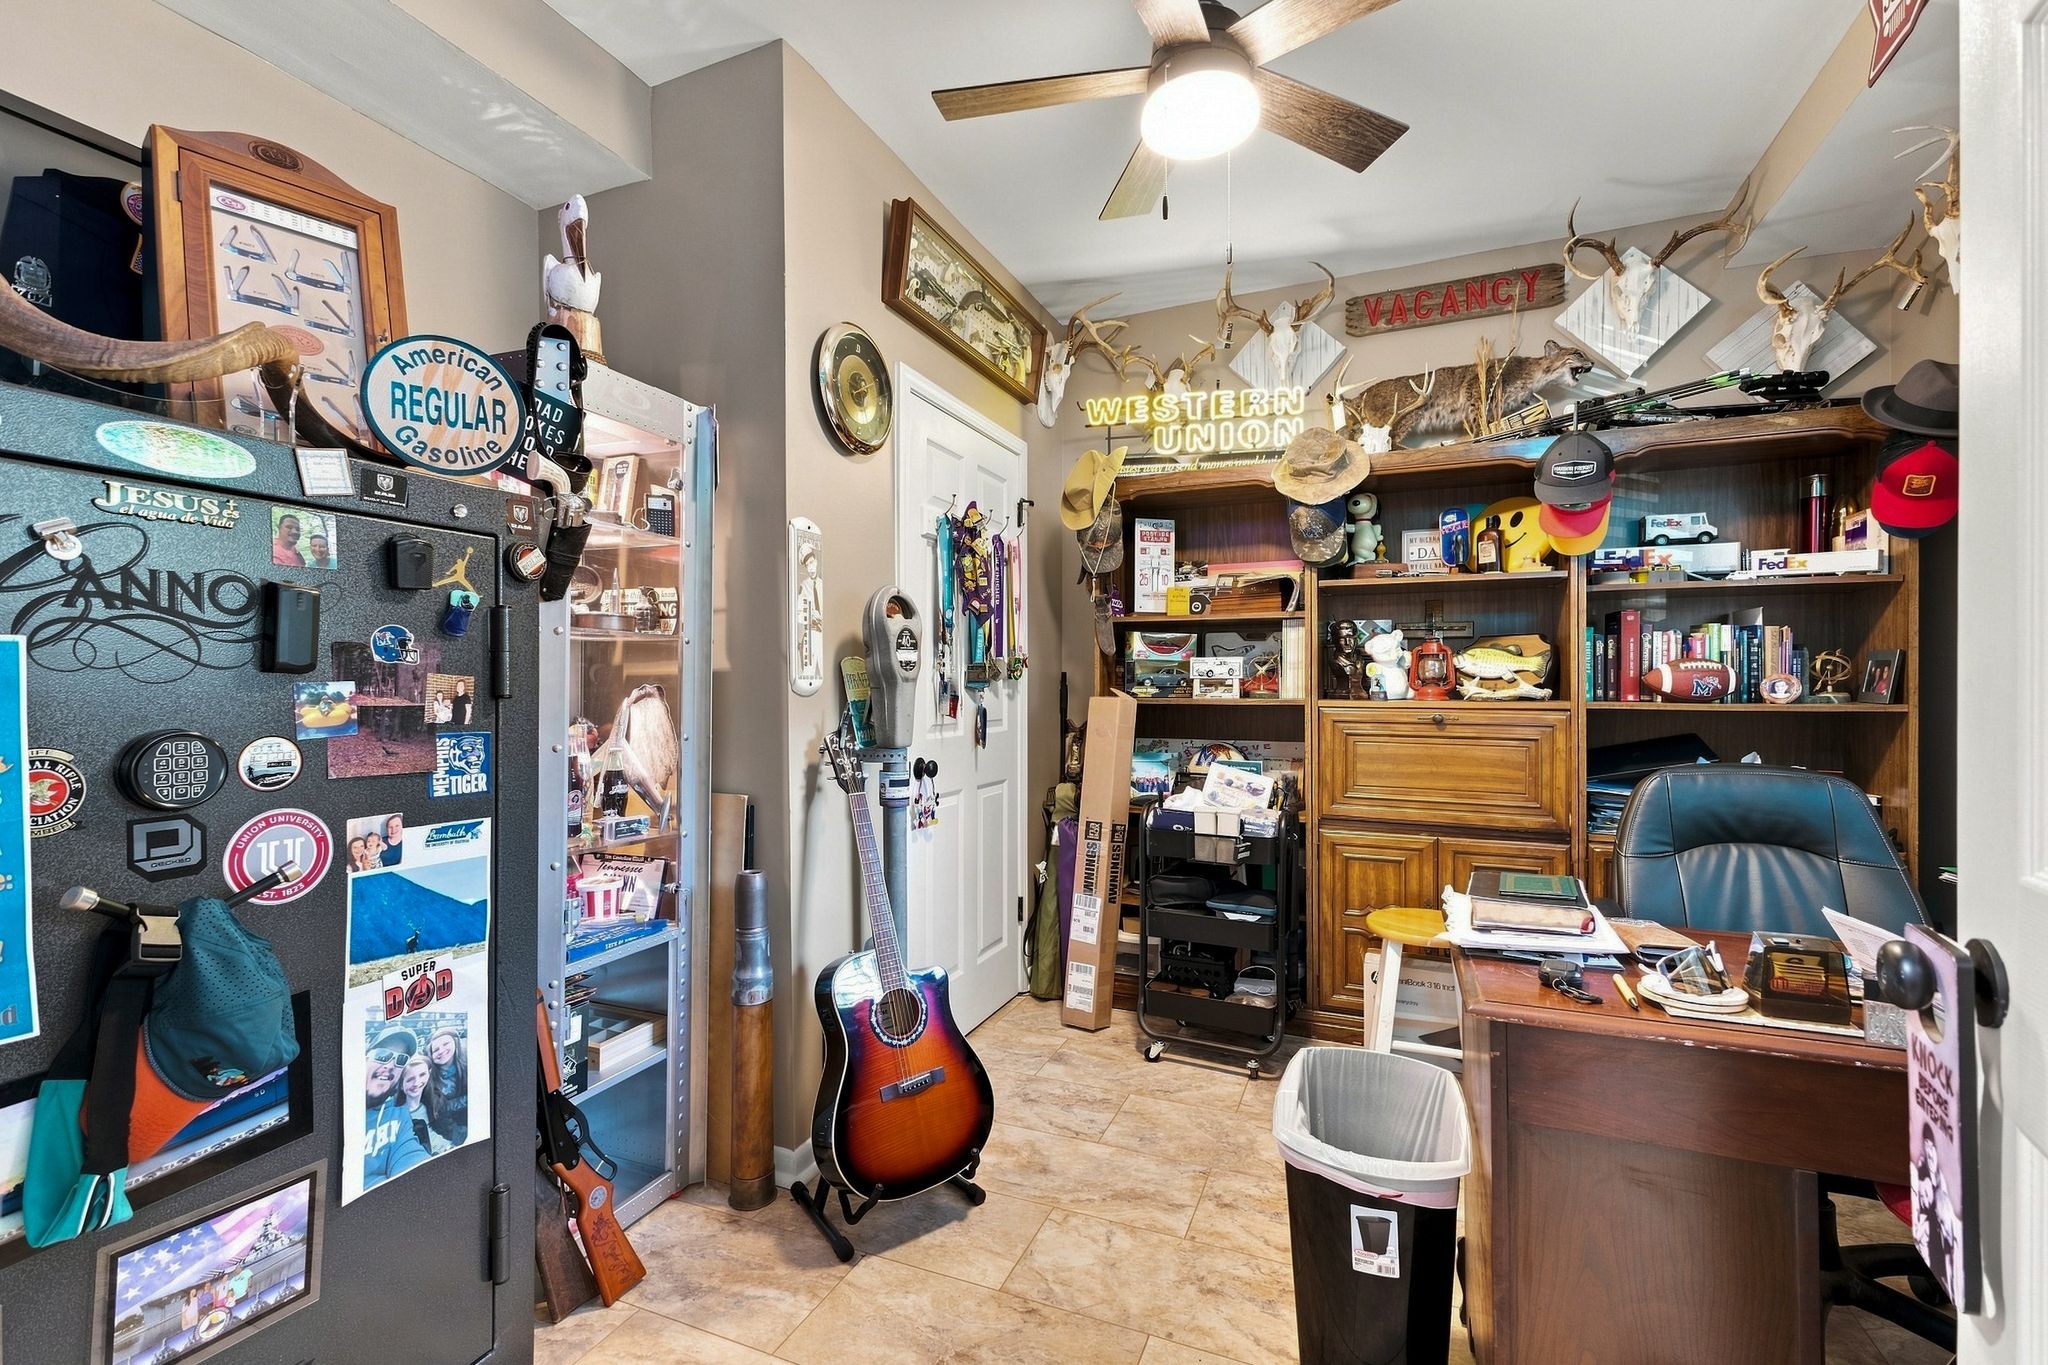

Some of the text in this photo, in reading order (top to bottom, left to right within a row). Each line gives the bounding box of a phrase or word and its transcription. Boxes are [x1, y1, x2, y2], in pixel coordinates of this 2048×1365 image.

[1364, 269, 1541, 327] VACANCY
[391, 347, 503, 393] American
[390, 380, 508, 436] REGULAR
[1086, 385, 1305, 426] WESTERN
[525, 415, 566, 444] OKES
[1153, 417, 1305, 455] UNION
[395, 425, 503, 467] Gasoline
[507, 451, 529, 470] HE
[94, 480, 220, 516] JESUS
[374, 490, 397, 499] RAM
[119, 504, 234, 529] el agua de Vida
[1651, 518, 1682, 528] FedEx
[1417, 547, 1438, 559] DA
[1758, 556, 1808, 570] FedEx
[55, 765, 82, 790] RIFLE
[433, 737, 451, 798] MEMPHIS
[450, 774, 488, 796] TIGER
[30, 798, 79, 826] CIATION
[31, 821, 72, 837] MBER
[236, 814, 325, 849] UNION UNIVERSITY
[150, 856, 192, 869] DECKED
[596, 861, 644, 873] Tennessee
[1108, 844, 1122, 904] AWNINGS
[281, 883, 306, 897] 1823
[401, 958, 437, 982] SUPER
[1911, 1032, 1954, 1098] KNOCK
[1918, 1071, 1949, 1118] BEFORE
[1915, 1087, 1954, 1145] ENTERING
